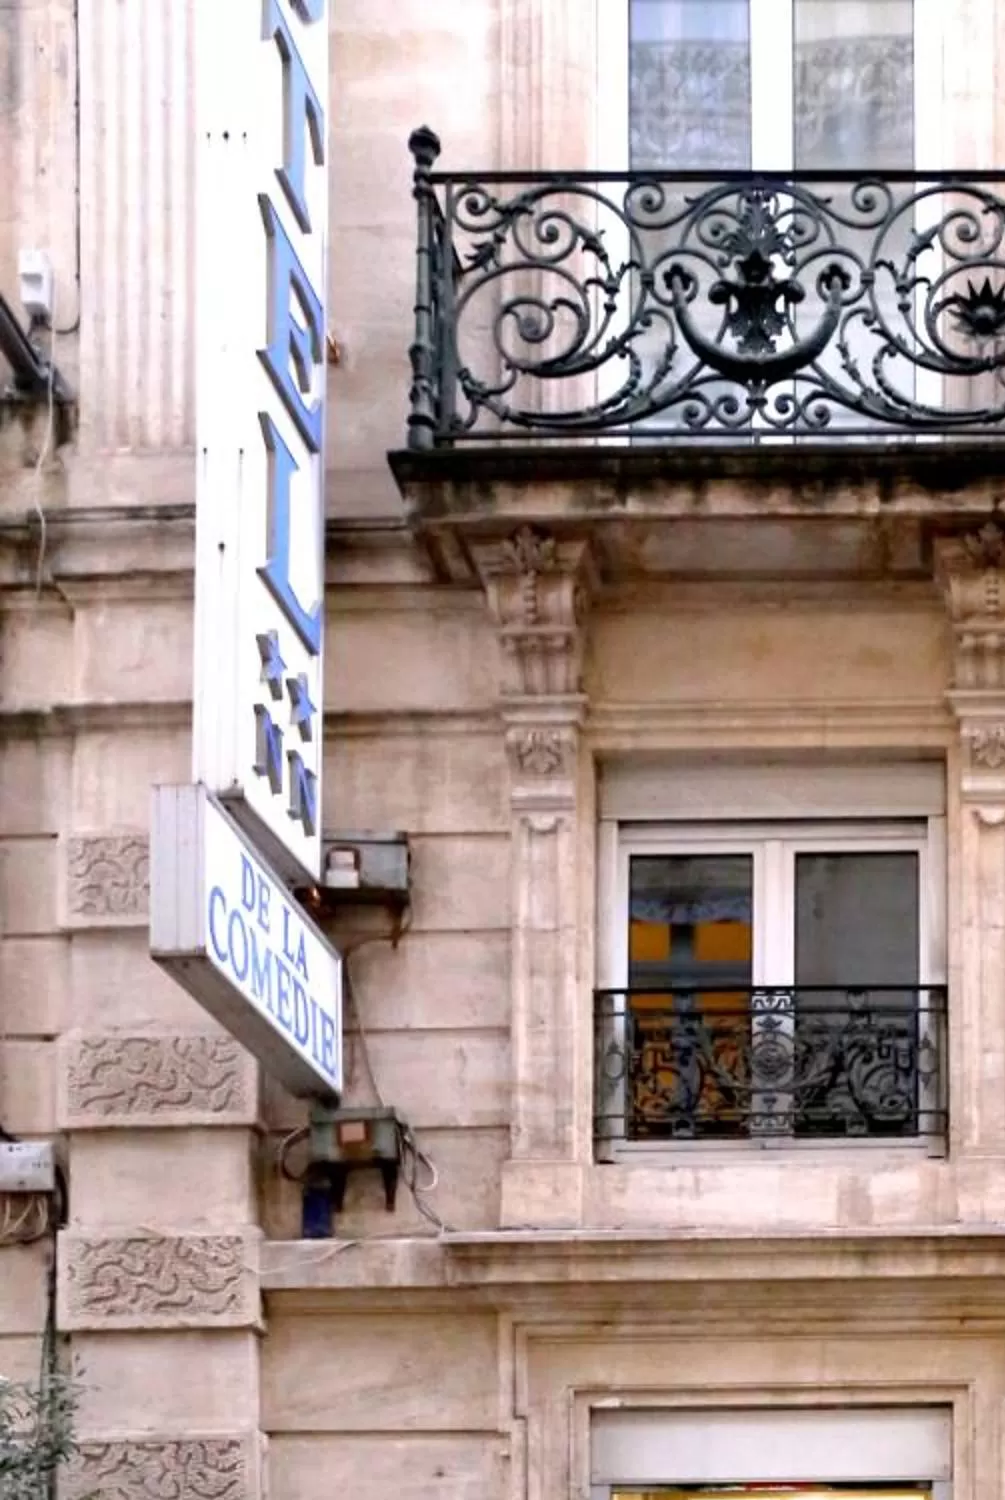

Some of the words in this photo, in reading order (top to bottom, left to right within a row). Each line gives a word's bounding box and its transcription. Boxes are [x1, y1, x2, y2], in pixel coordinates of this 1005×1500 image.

[256, 0, 325, 657] TEL
[208, 885, 336, 1079] COMEDIE
[240, 851, 271, 933] DE
[282, 904, 309, 982] LA
